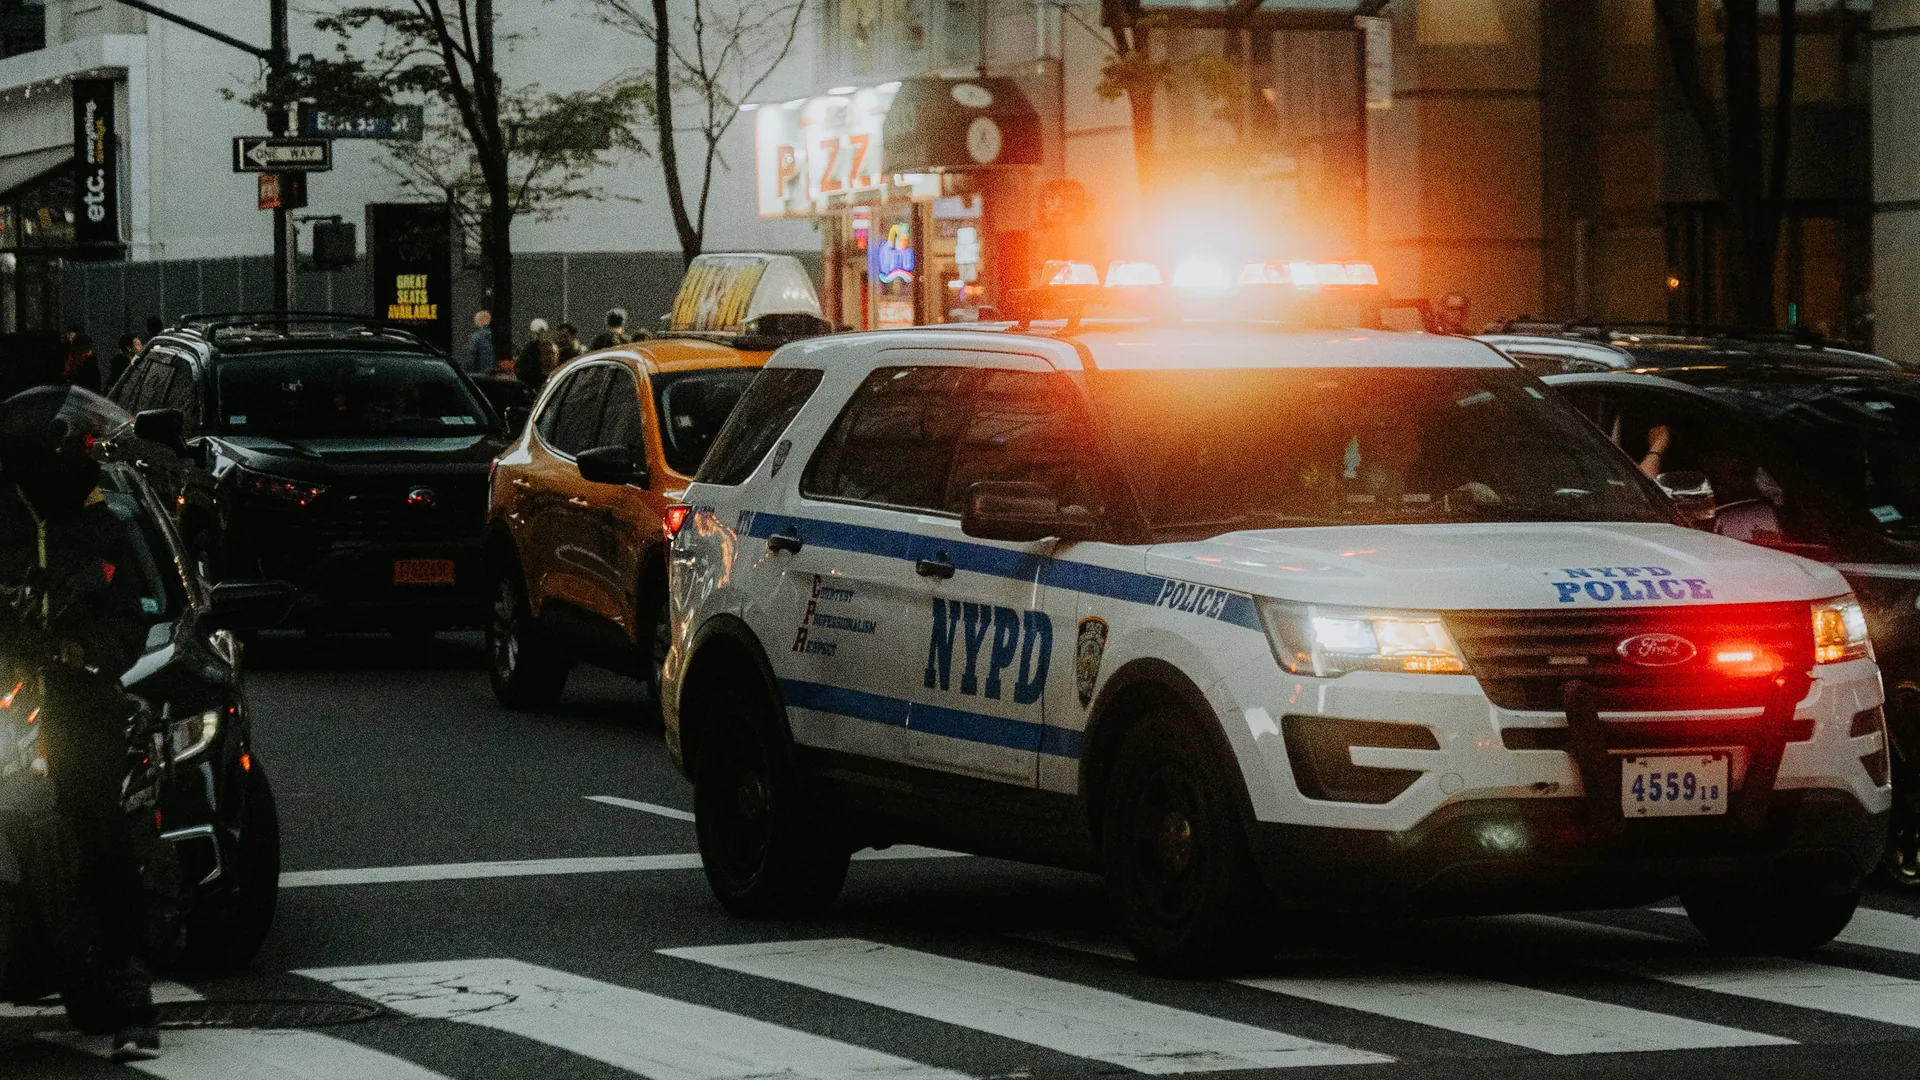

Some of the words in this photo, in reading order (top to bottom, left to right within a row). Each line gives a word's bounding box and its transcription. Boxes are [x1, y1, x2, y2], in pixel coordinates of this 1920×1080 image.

[256, 151, 276, 160] ONE
[291, 150, 315, 160] WAY
[84, 169, 105, 222] etc.
[396, 274, 428, 289] GREAT
[397, 290, 427, 304] SEATS
[388, 304, 438, 319] AVAILABLE
[1562, 566, 1672, 578] NYPD
[1158, 580, 1225, 619] POLICE
[1553, 579, 1713, 602] POLICE
[925, 599, 1052, 704] NYPD
[1639, 637, 1680, 657] Ford
[1631, 771, 1697, 802] 4559
[1700, 785, 1719, 800] 18
